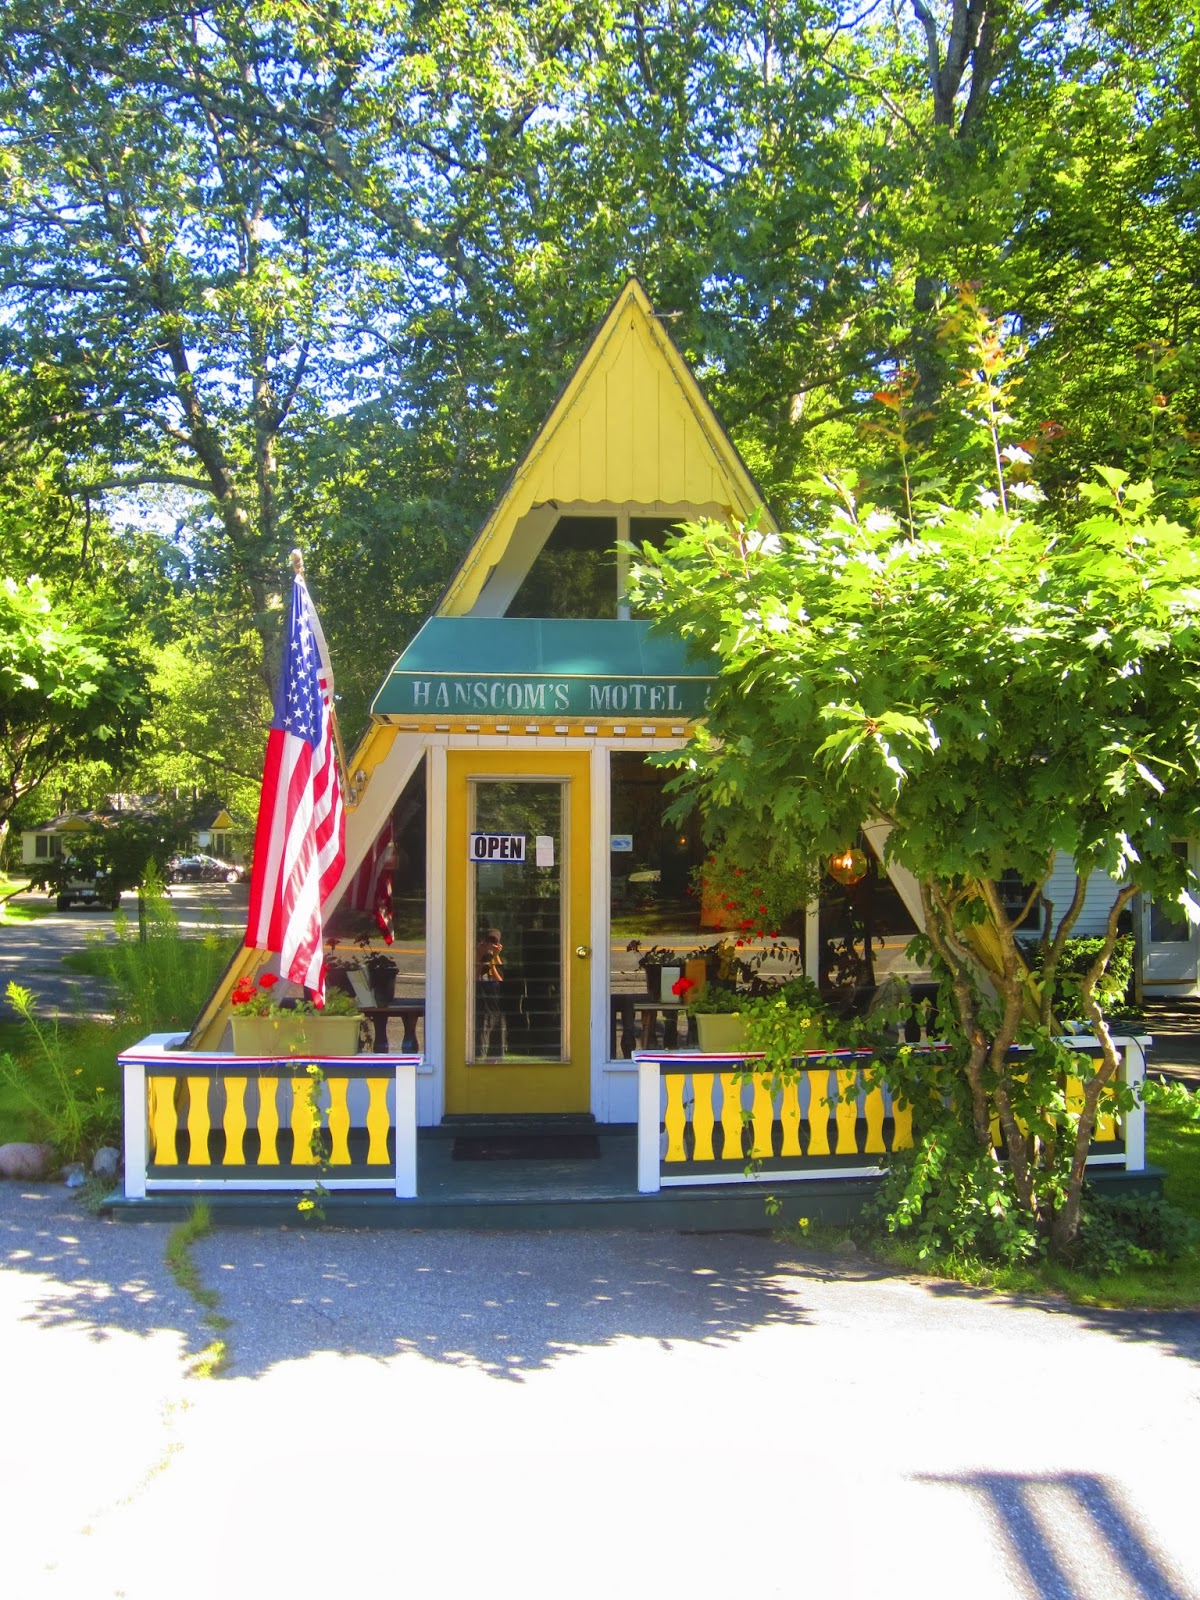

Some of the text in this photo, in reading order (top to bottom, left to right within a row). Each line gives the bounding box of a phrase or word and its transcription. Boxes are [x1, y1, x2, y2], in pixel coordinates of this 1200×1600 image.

[411, 680, 570, 710] HANSCOM'S
[588, 684, 683, 711] MOTEL
[474, 836, 522, 859] OPEN
